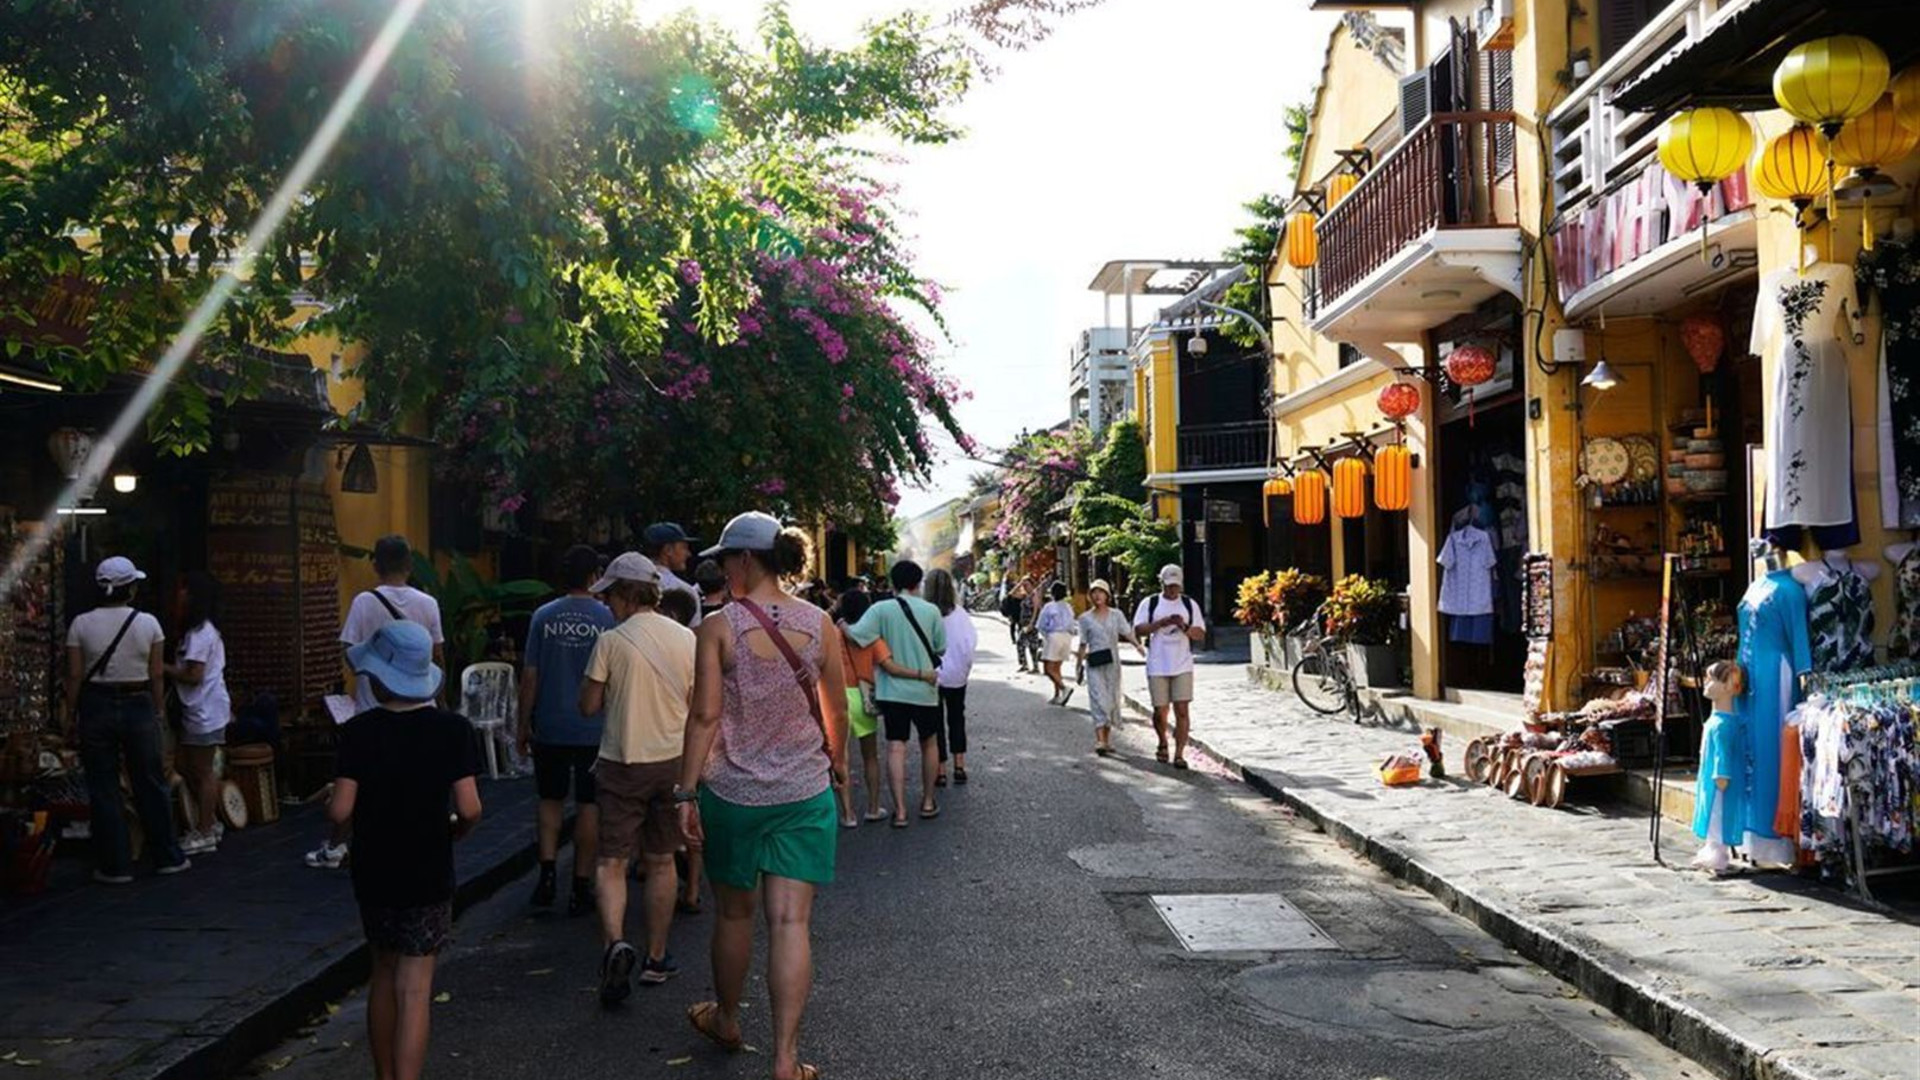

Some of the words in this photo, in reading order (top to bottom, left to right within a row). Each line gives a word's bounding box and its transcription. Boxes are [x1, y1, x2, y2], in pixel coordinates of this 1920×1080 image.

[210, 508, 291, 526] はんこ
[544, 622, 605, 639] NIXON
